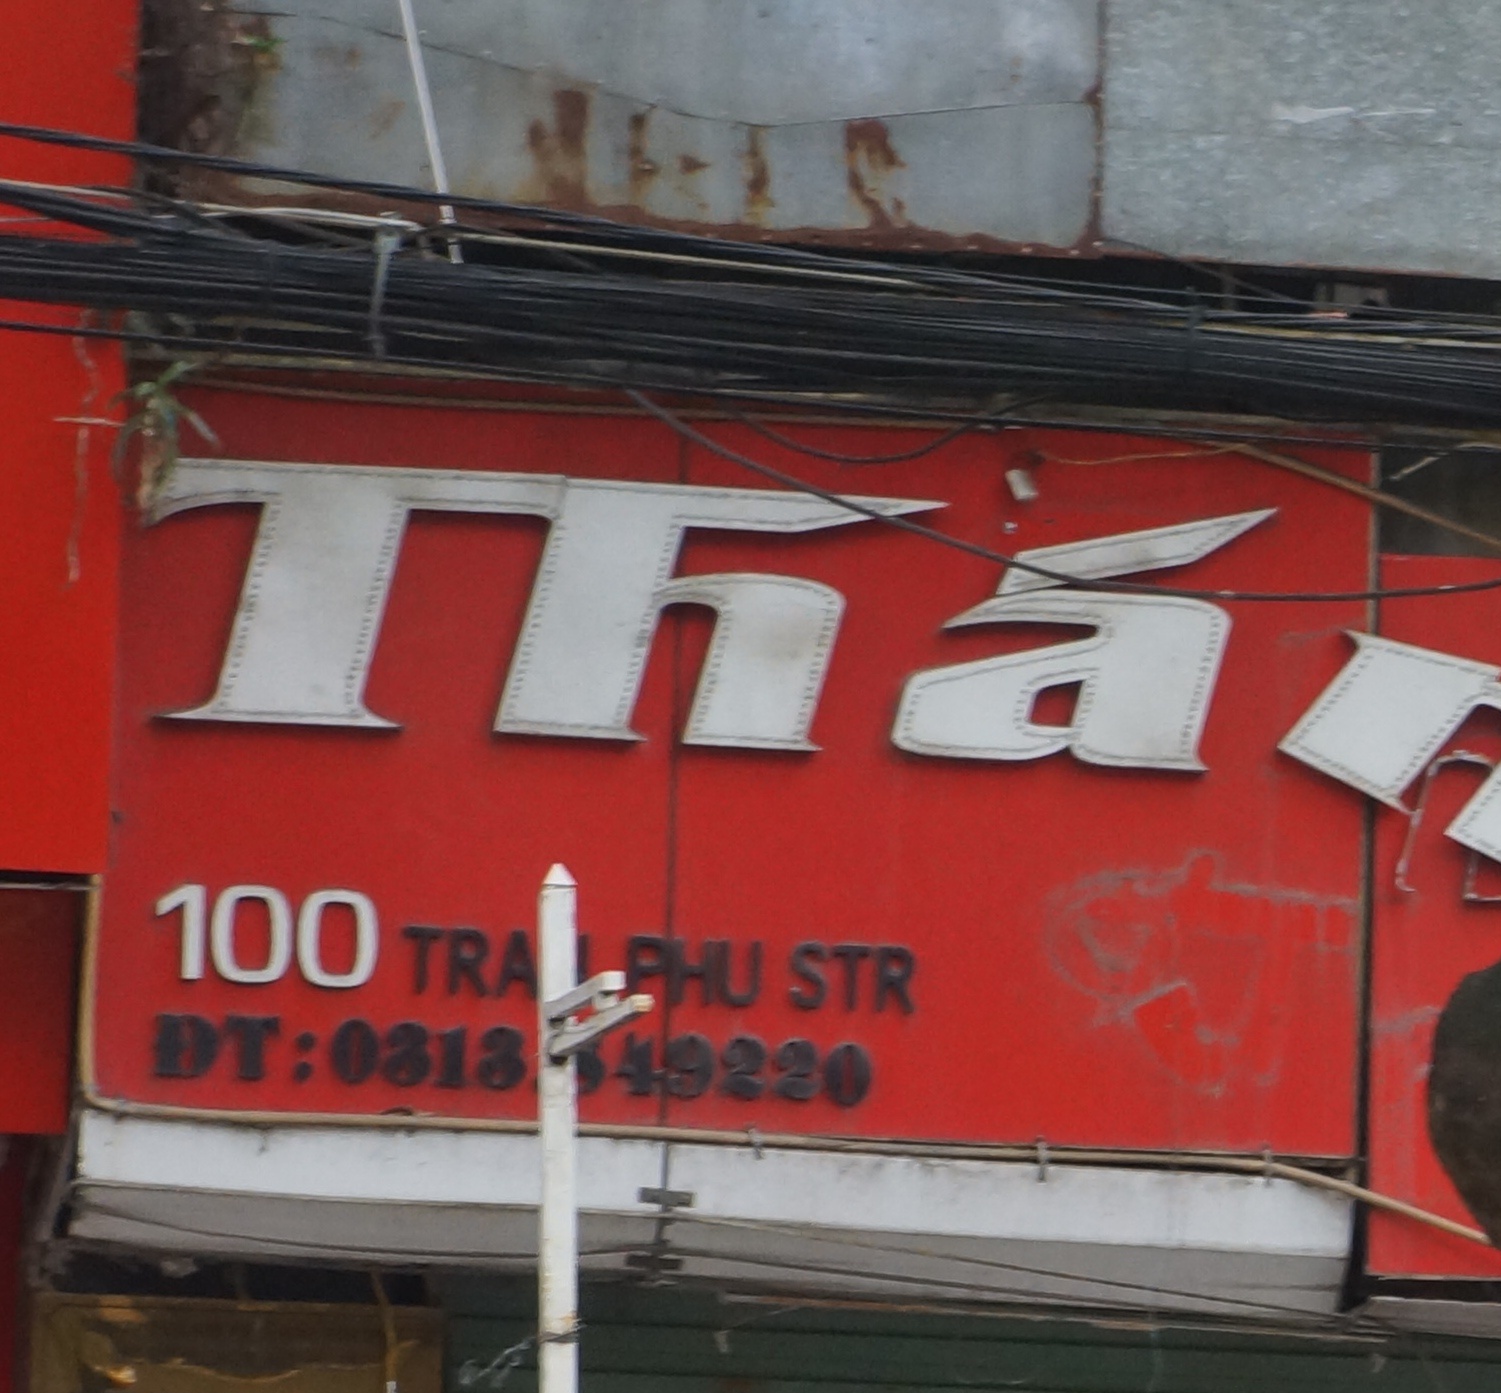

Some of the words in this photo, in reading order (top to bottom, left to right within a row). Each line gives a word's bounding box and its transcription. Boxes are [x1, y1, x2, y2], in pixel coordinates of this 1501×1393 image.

[154, 883, 380, 988] 100
[403, 925, 588, 1000] TRA
[626, 934, 763, 1007] PHU
[788, 940, 916, 1014] STR
